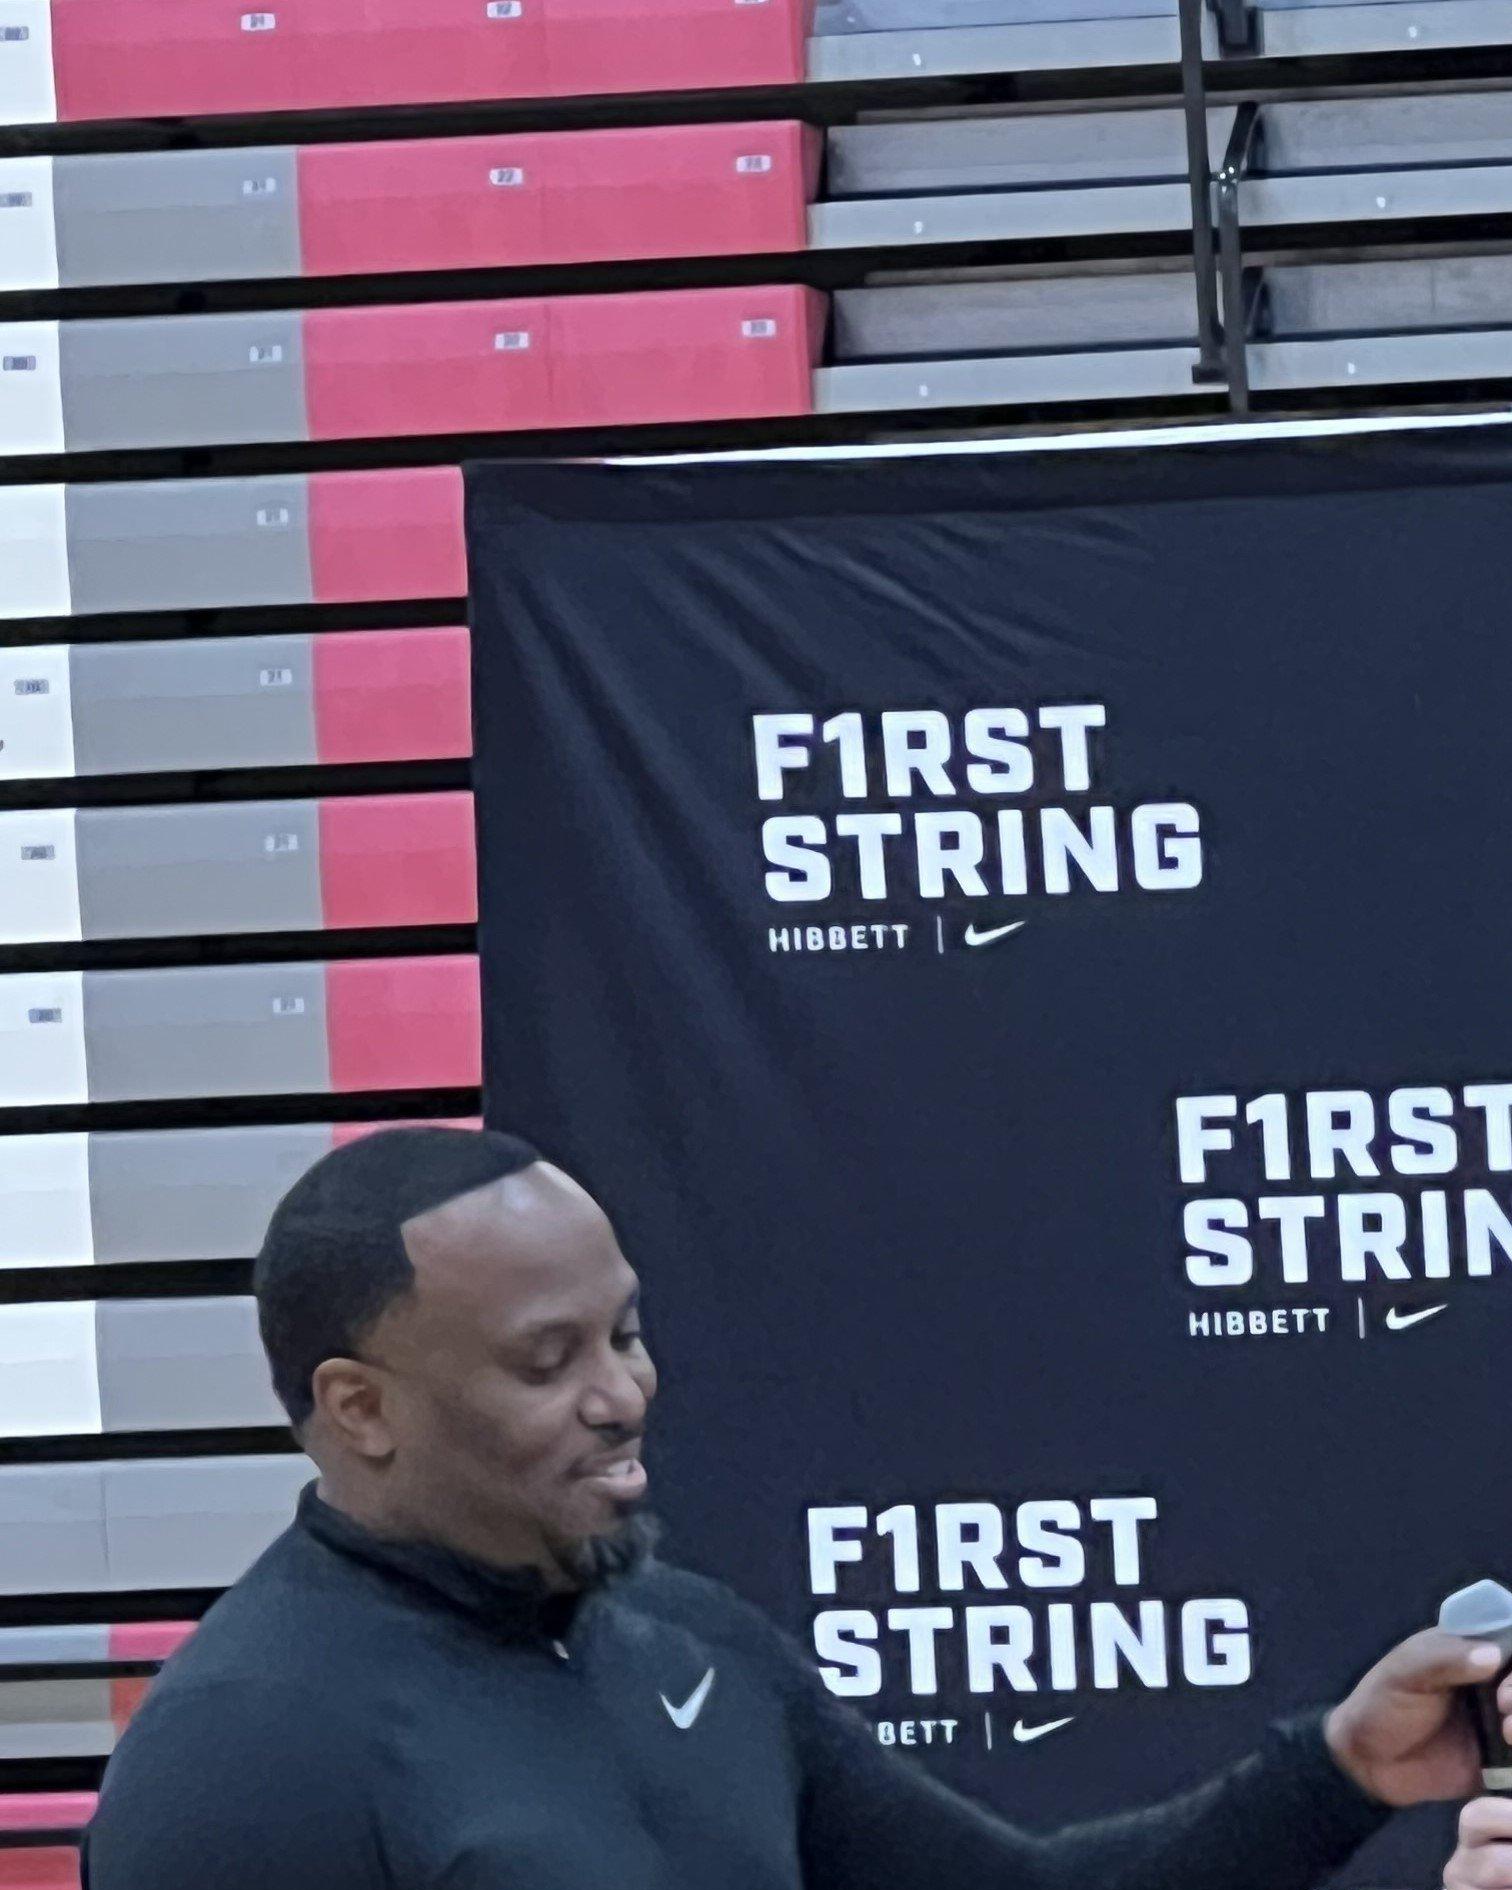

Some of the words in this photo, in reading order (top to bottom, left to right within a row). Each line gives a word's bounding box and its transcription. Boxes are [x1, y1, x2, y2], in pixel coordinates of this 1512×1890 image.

[752, 704, 1106, 801] F1RST
[762, 802, 1203, 902] STRING
[768, 923, 909, 952] HIBBETT
[1189, 1308, 1330, 1337] HIBBETT
[807, 1497, 1158, 1595] F1RST
[813, 1598, 1251, 1697] STRING
[877, 1719, 958, 1746] BETT
